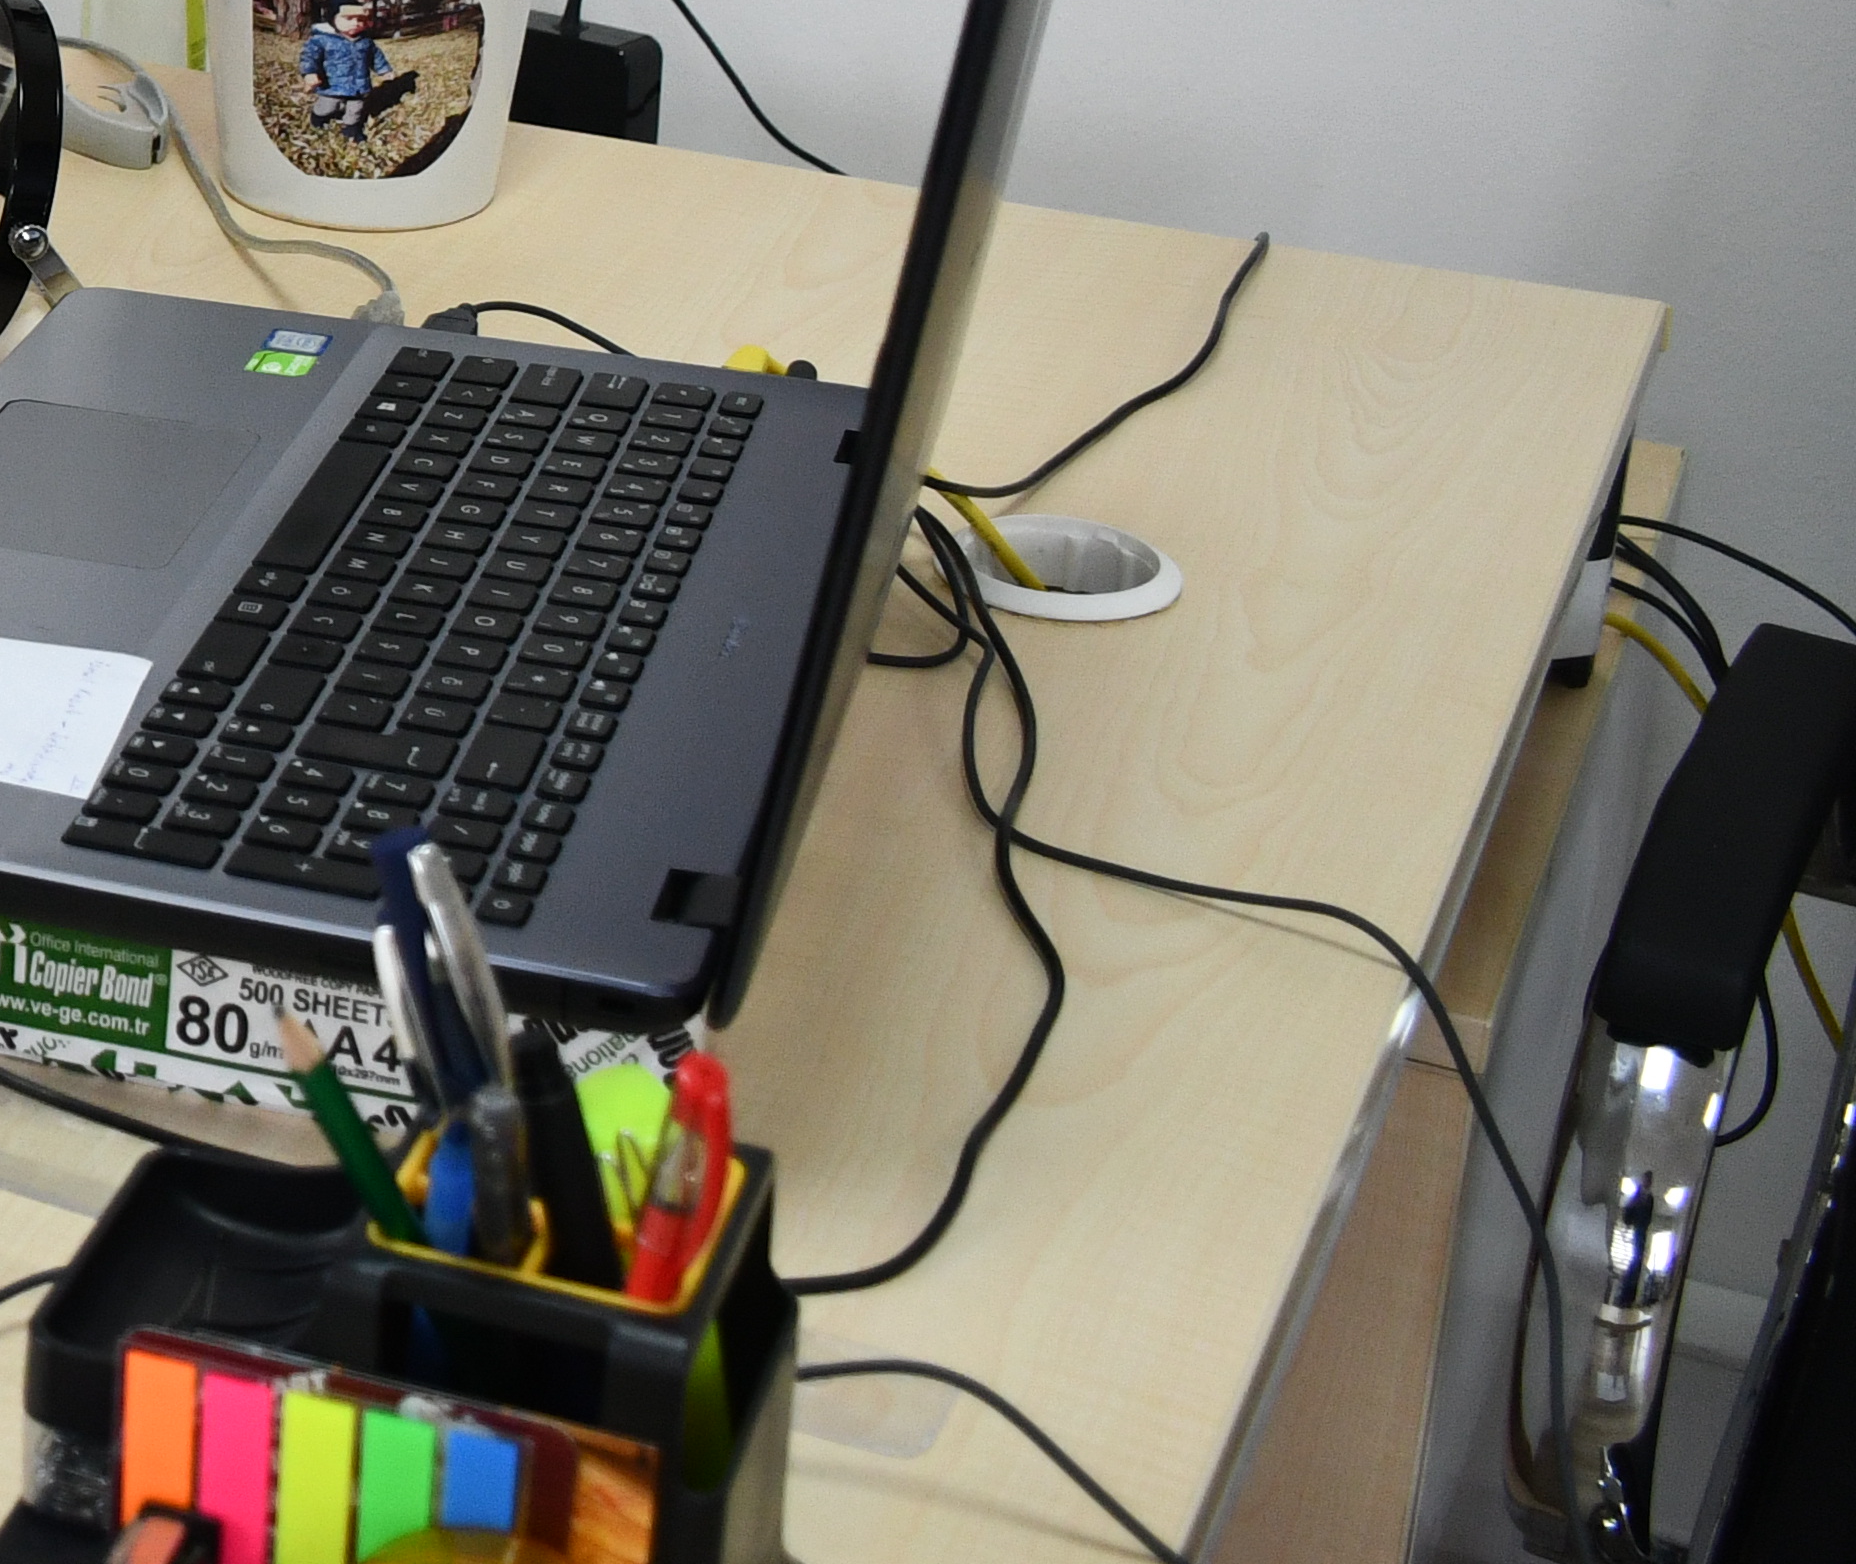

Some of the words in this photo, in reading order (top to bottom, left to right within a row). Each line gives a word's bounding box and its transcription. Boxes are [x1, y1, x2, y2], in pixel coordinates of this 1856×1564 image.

[30, 932, 71, 952] Office
[74, 939, 159, 968] International
[29, 949, 100, 997] Copier
[99, 963, 154, 1008] Bond
[238, 977, 284, 1005] 500
[293, 988, 392, 1028] SHEET
[176, 994, 249, 1054] 80
